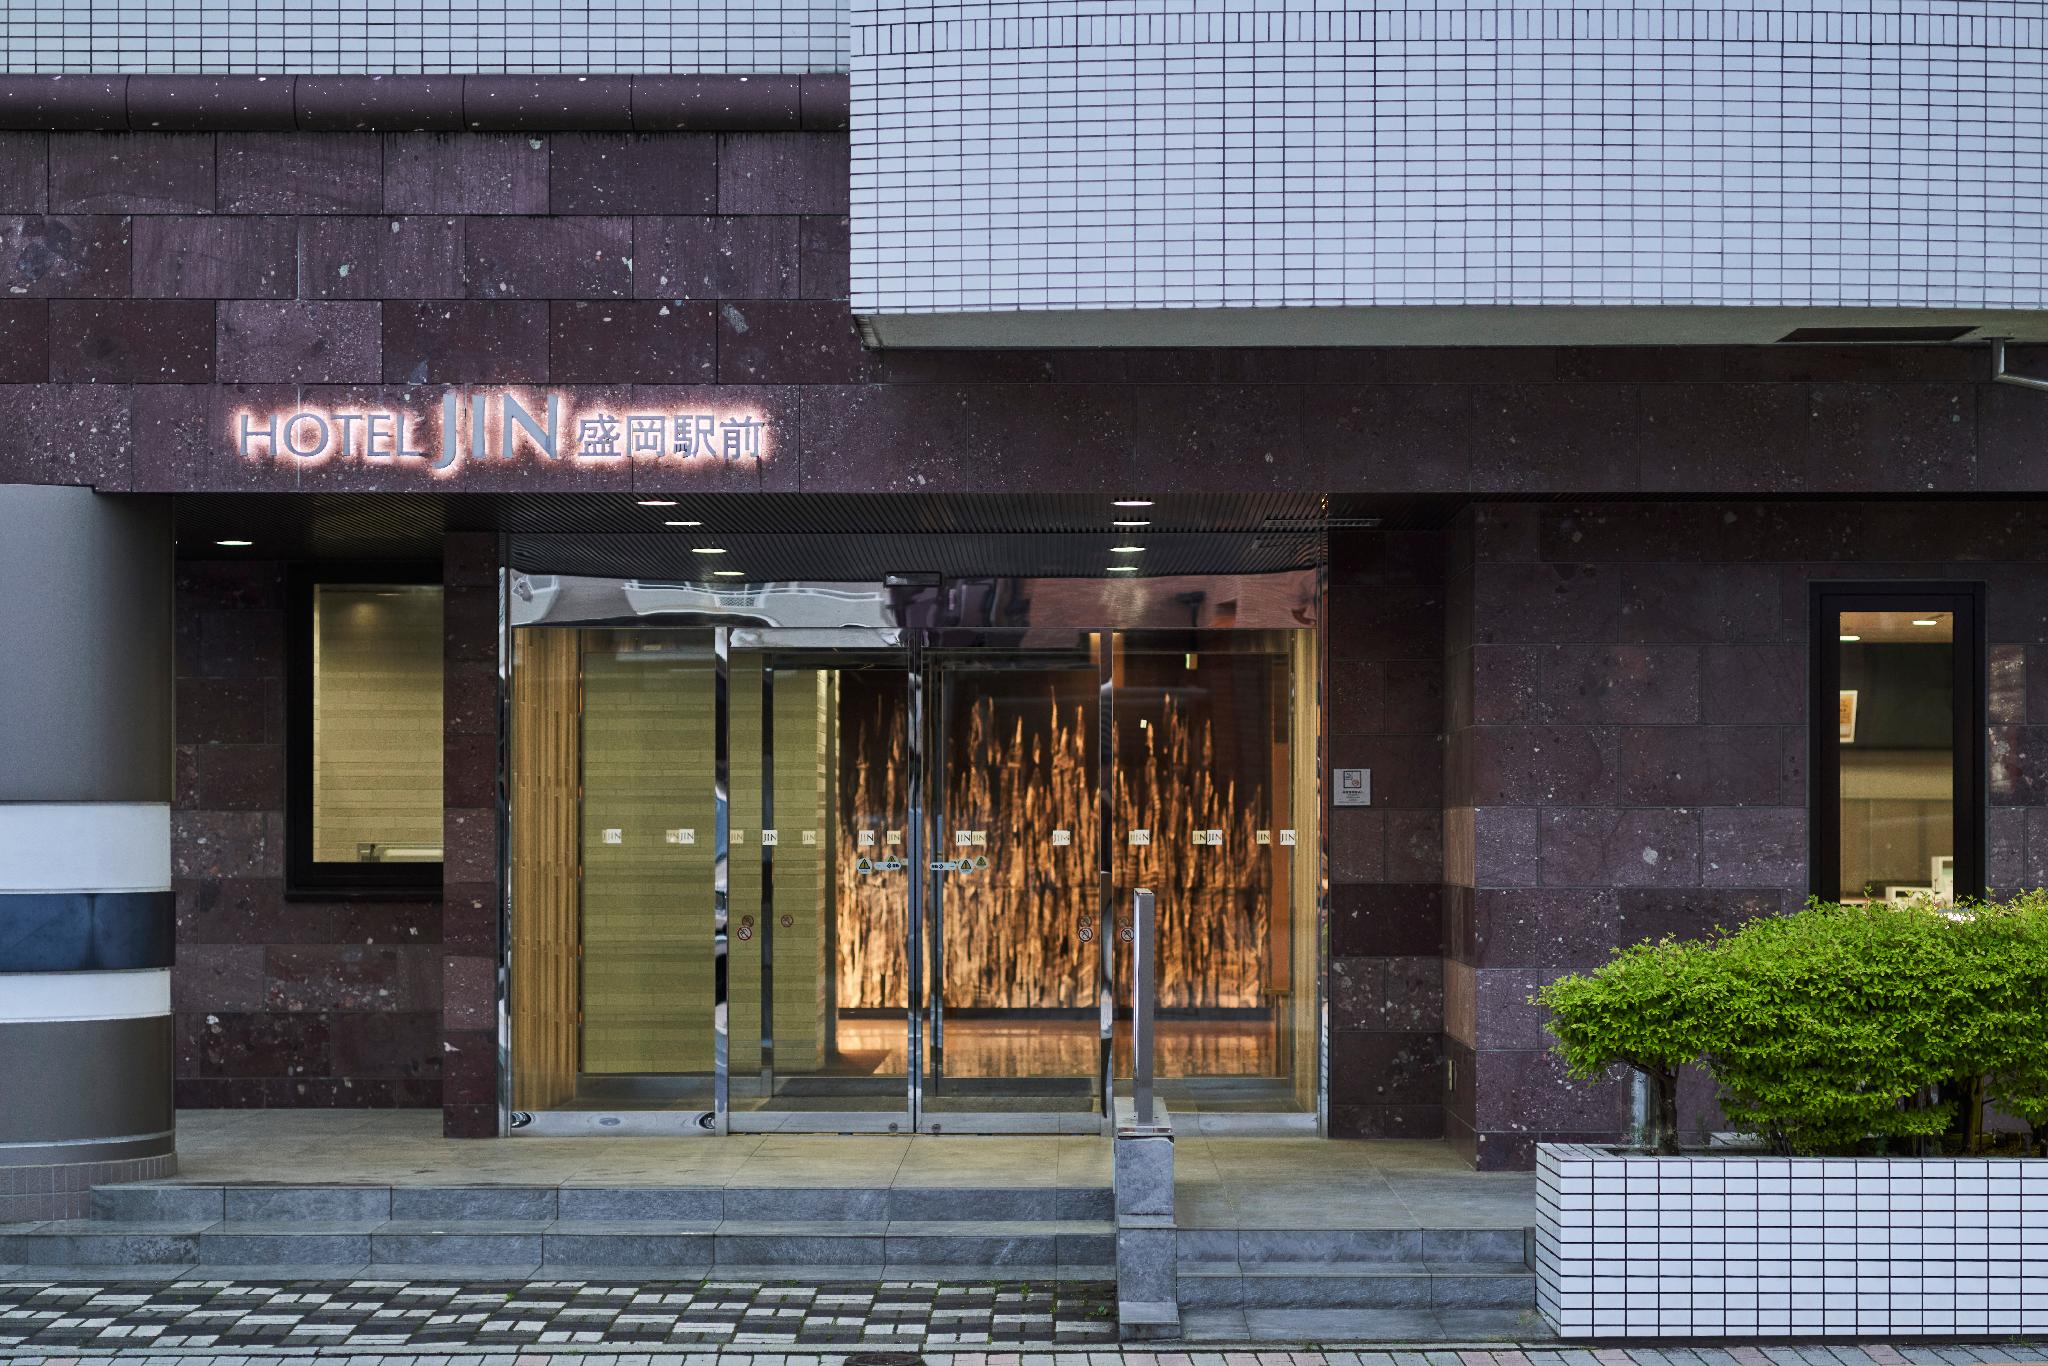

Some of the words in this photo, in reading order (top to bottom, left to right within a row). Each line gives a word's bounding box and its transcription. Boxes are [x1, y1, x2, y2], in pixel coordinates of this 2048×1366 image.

[239, 413, 427, 457] HOTEL
[432, 393, 559, 470] JIN
[577, 413, 764, 460] 盛岡駅前
